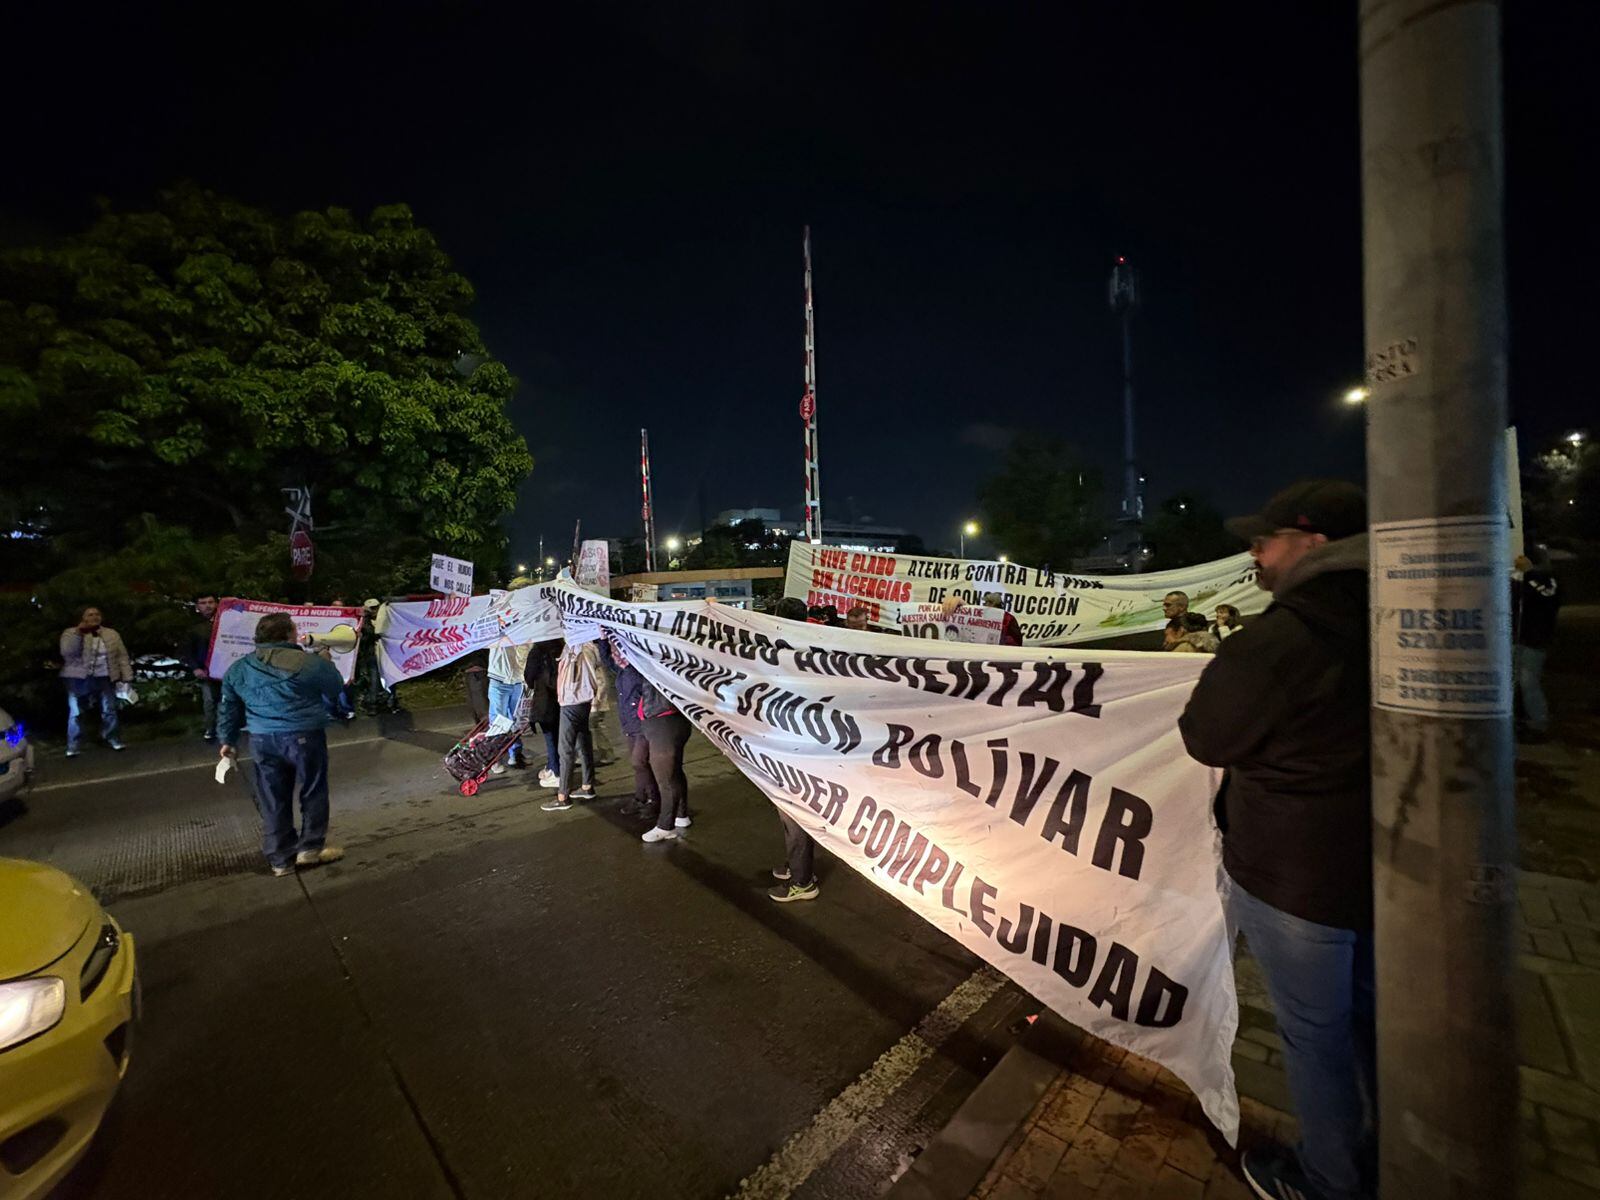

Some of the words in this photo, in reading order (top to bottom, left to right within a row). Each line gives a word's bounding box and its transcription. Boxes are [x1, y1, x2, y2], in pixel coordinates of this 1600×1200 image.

[292, 546, 312, 566] PARE
[447, 560, 454, 572] EL
[851, 553, 897, 577] CLARO
[907, 560, 960, 581] ATENTA
[964, 564, 1028, 586] CONTRA
[1035, 569, 1055, 588] LA
[433, 575, 439, 586] NO
[445, 578, 454, 590] NOS
[812, 569, 833, 589] SIN
[837, 573, 912, 603] LICENCIAS
[929, 587, 947, 605] DE
[424, 597, 470, 618] ALCALDE
[918, 605, 931, 613] POR
[933, 605, 942, 613] LA
[974, 608, 984, 618] DE
[902, 613, 927, 624] NUESTRA
[958, 616, 965, 625] EL
[967, 618, 1002, 631] AMBIENTE
[1399, 608, 1483, 630] DESDE
[903, 622, 940, 641] NO
[639, 609, 662, 631] EL
[670, 610, 793, 666] ATENTADO
[794, 646, 1104, 719] AMBIENTAL
[659, 642, 748, 702] PARQUE
[737, 682, 862, 754] SIMÓN
[872, 722, 1154, 881] BOLÍVAR
[707, 720, 849, 826] CUALQUIER
[848, 795, 1189, 1028] COMPLEJIDAD
